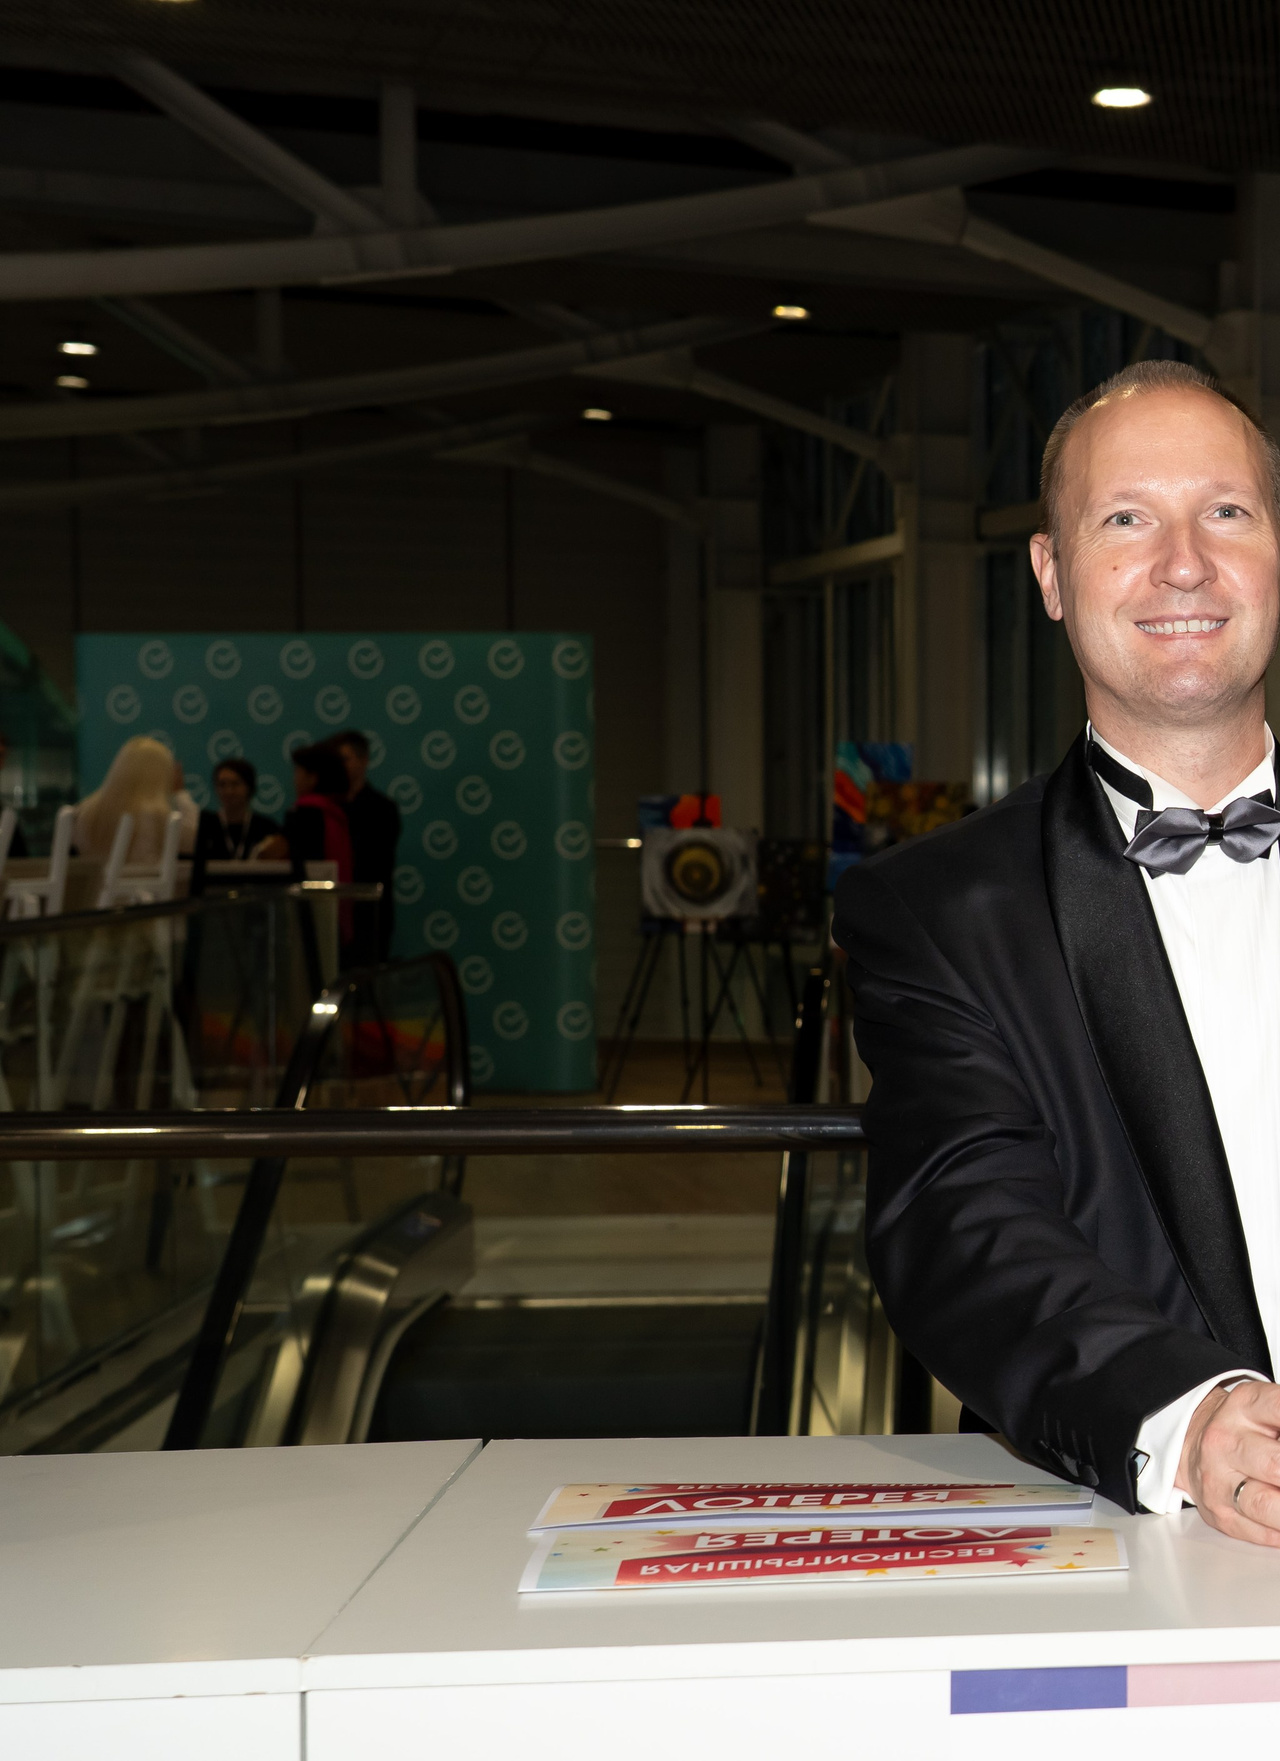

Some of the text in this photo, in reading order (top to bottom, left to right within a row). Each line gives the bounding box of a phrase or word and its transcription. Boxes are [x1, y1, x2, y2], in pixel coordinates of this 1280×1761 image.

[633, 1491, 949, 1514] ЛОТЕРЕЯ
[695, 1528, 1020, 1549] ЛОТЕРЕЯ
[640, 1548, 995, 1575] БЕСПРОИГРЫШНАЯ
